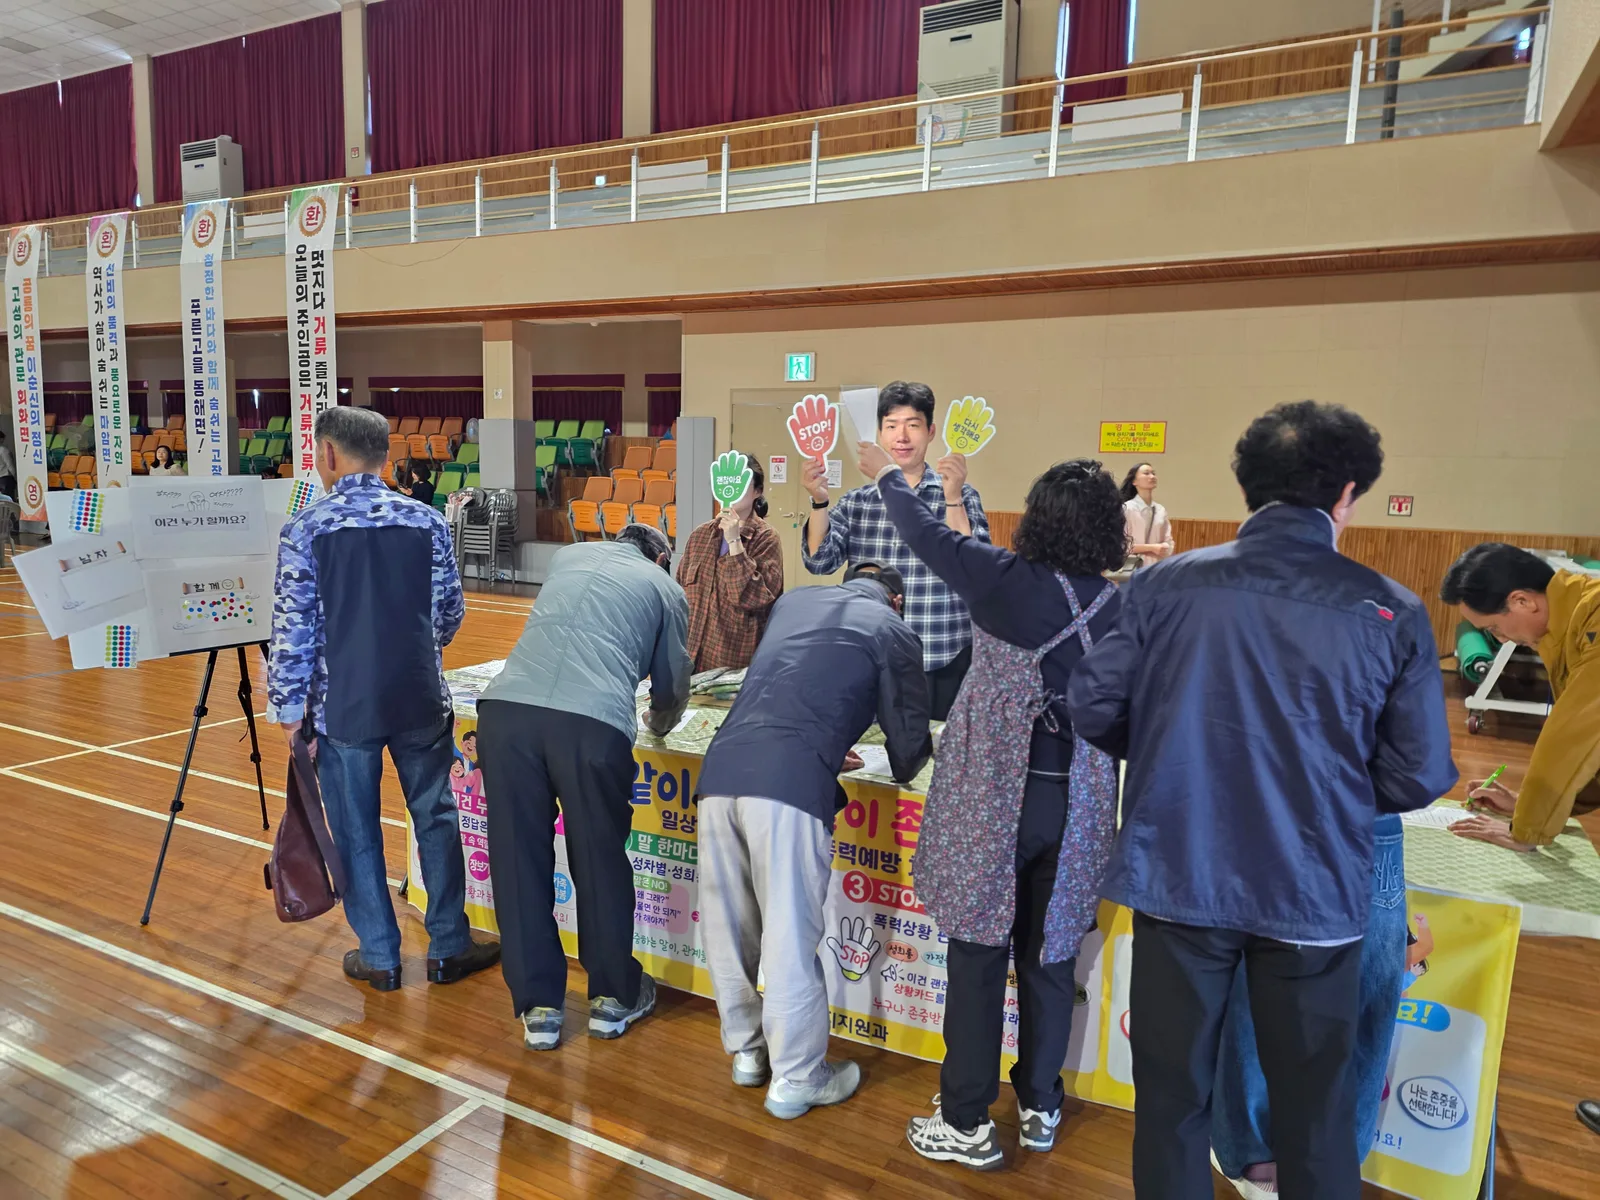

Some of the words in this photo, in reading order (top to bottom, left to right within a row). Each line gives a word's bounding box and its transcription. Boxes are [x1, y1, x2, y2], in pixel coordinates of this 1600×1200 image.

[198, 218, 211, 239] 환
[305, 205, 321, 227] 환
[17, 241, 27, 258] 환
[101, 230, 113, 249] 환
[106, 263, 116, 309] 선비의
[204, 253, 215, 301] 청정한
[295, 244, 308, 303] 오늘의
[311, 249, 326, 310] 멋지다
[93, 266, 103, 315] 역사가
[12, 286, 23, 340] 고성의
[25, 335, 35, 351] 꿈
[95, 320, 105, 352] 살아
[108, 315, 118, 362] 품격과
[205, 307, 217, 354] 바다와
[313, 316, 327, 356] 거류
[296, 309, 311, 388] 주인공은
[14, 347, 25, 382] 관문
[98, 358, 106, 373] 숨
[207, 360, 219, 390] 함께
[27, 357, 40, 426] 이순신의
[111, 368, 122, 429] 풍요로운
[17, 389, 30, 458] 회화면!
[193, 379, 206, 454] 동해면!
[798, 418, 832, 441] STOP!
[963, 418, 979, 431] 다시
[953, 422, 980, 443] 생각해요
[31, 431, 43, 465] 정신
[100, 415, 111, 477] 마암면!
[114, 435, 123, 465] 자연
[716, 475, 742, 485] 괜찮아요
[154, 517, 178, 527] 이건
[181, 516, 204, 527] 누가
[206, 515, 246, 526] 할까요?
[662, 810, 698, 834] 일상
[833, 799, 879, 839] 이
[638, 834, 653, 852] 말
[633, 856, 700, 883] 성차별·성희
[637, 891, 645, 900] 왜
[651, 879, 668, 891] NO!
[849, 874, 865, 899] 3
[653, 905, 661, 915] 안
[873, 913, 932, 940] 폭력상황
[840, 945, 870, 968] STOP
[889, 944, 914, 960] 성희롱
[926, 952, 949, 964] 가정
[907, 972, 927, 986] 이건
[873, 997, 905, 1015] 누구나
[893, 983, 945, 1005] 상황카드를
[1410, 1083, 1428, 1101] 나는
[1430, 1090, 1458, 1109] 존중을
[1408, 1097, 1458, 1123] 선택합니다!
